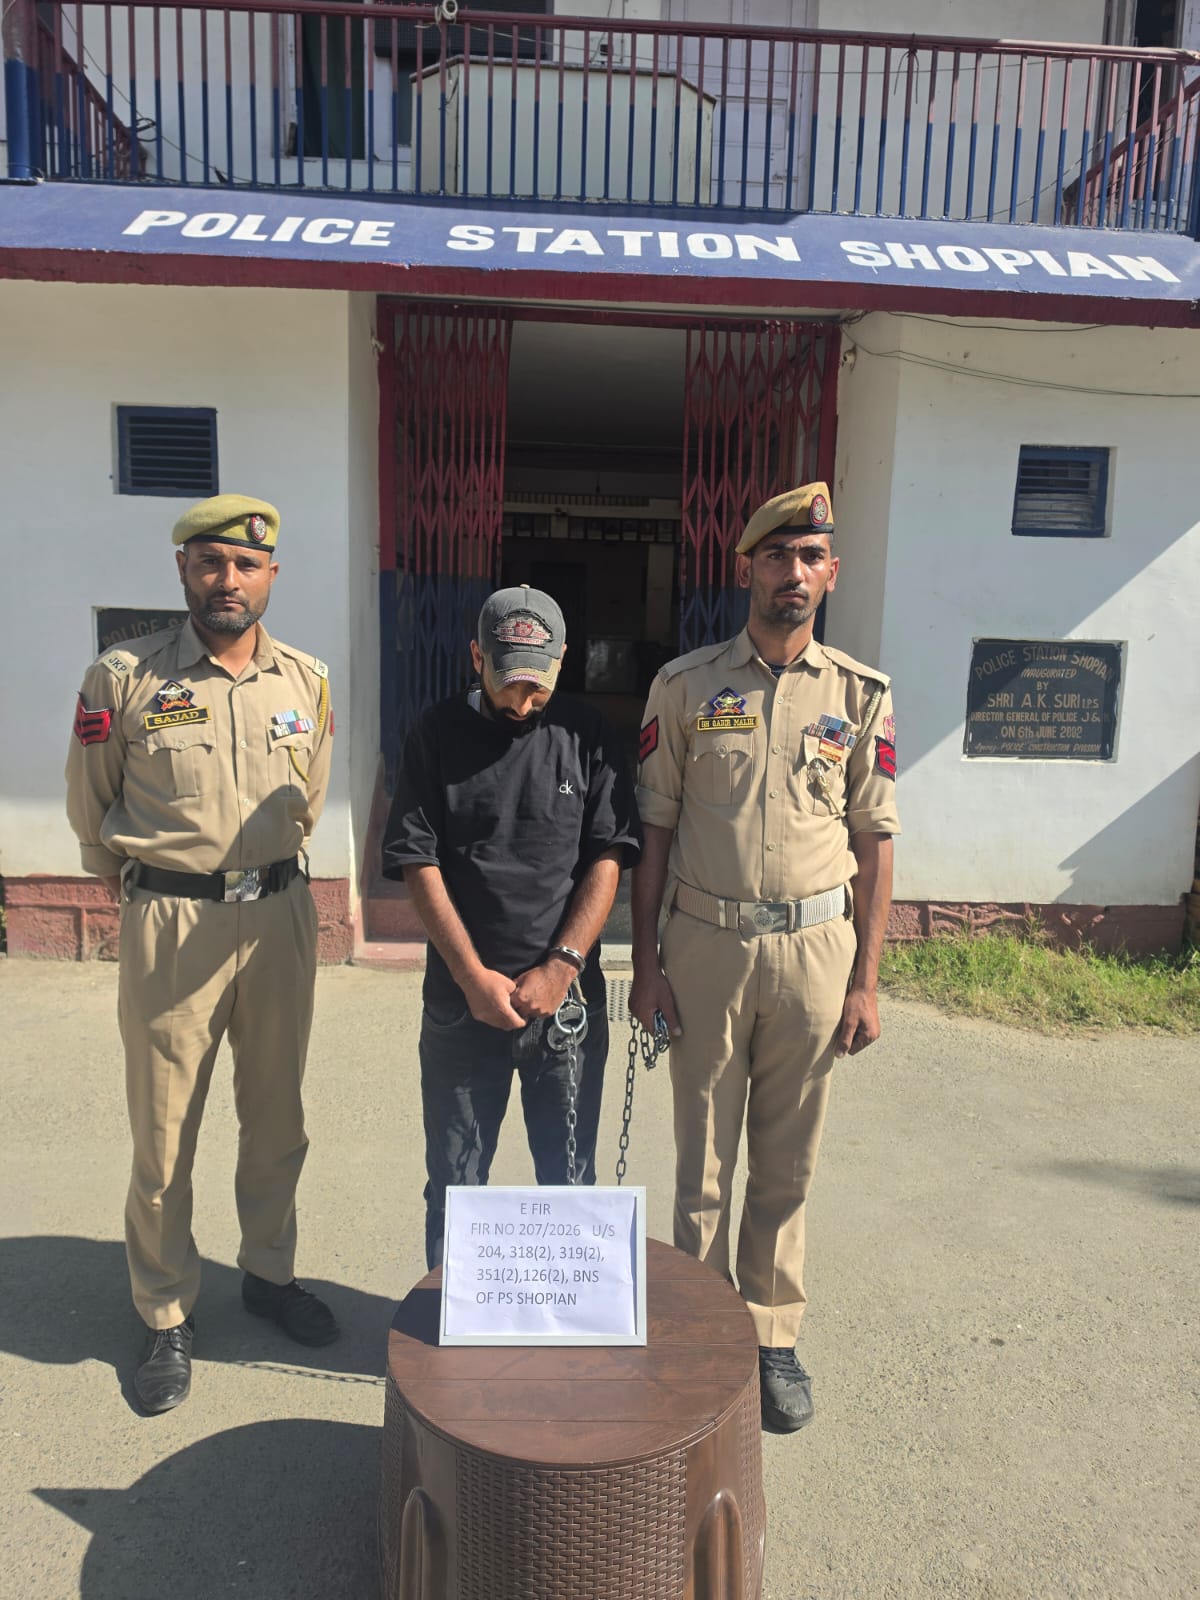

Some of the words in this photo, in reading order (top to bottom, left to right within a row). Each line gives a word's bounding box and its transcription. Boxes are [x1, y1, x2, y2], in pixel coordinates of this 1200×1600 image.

[122, 210, 395, 248] POLICE
[446, 225, 801, 262] STATION
[839, 240, 1182, 284] SHOPIAN
[108, 656, 128, 672] JKP
[974, 650, 1017, 681] POLICE
[1023, 646, 1067, 662] STATION
[1021, 668, 1079, 679] INAUGURATED
[1036, 681, 1049, 691] BY
[987, 692, 1014, 708] SHRI
[1054, 693, 1080, 709] SURI
[154, 711, 200, 725] SAJAD
[970, 711, 1005, 722] DIRECTOR
[1006, 711, 1040, 722] GENERAL
[1041, 711, 1051, 722] OF
[1052, 711, 1078, 722] POLICE
[1000, 726, 1016, 738] ON
[1035, 726, 1057, 738] JUNE
[1060, 726, 1084, 739] 2002
[520, 1202, 528, 1216] E
[532, 1203, 552, 1216] FIR
[471, 1222, 490, 1236] FIR
[494, 1222, 515, 1236] NO
[519, 1222, 582, 1239] 207/2026
[592, 1223, 616, 1239] U/S
[477, 1245, 506, 1261] 204,
[509, 1246, 556, 1262] 318(2),
[559, 1246, 605, 1263] 319(2),
[573, 1270, 600, 1283] BNS
[476, 1292, 494, 1304] OF
[498, 1292, 513, 1305] PS
[516, 1292, 577, 1306] SHOPIAN
